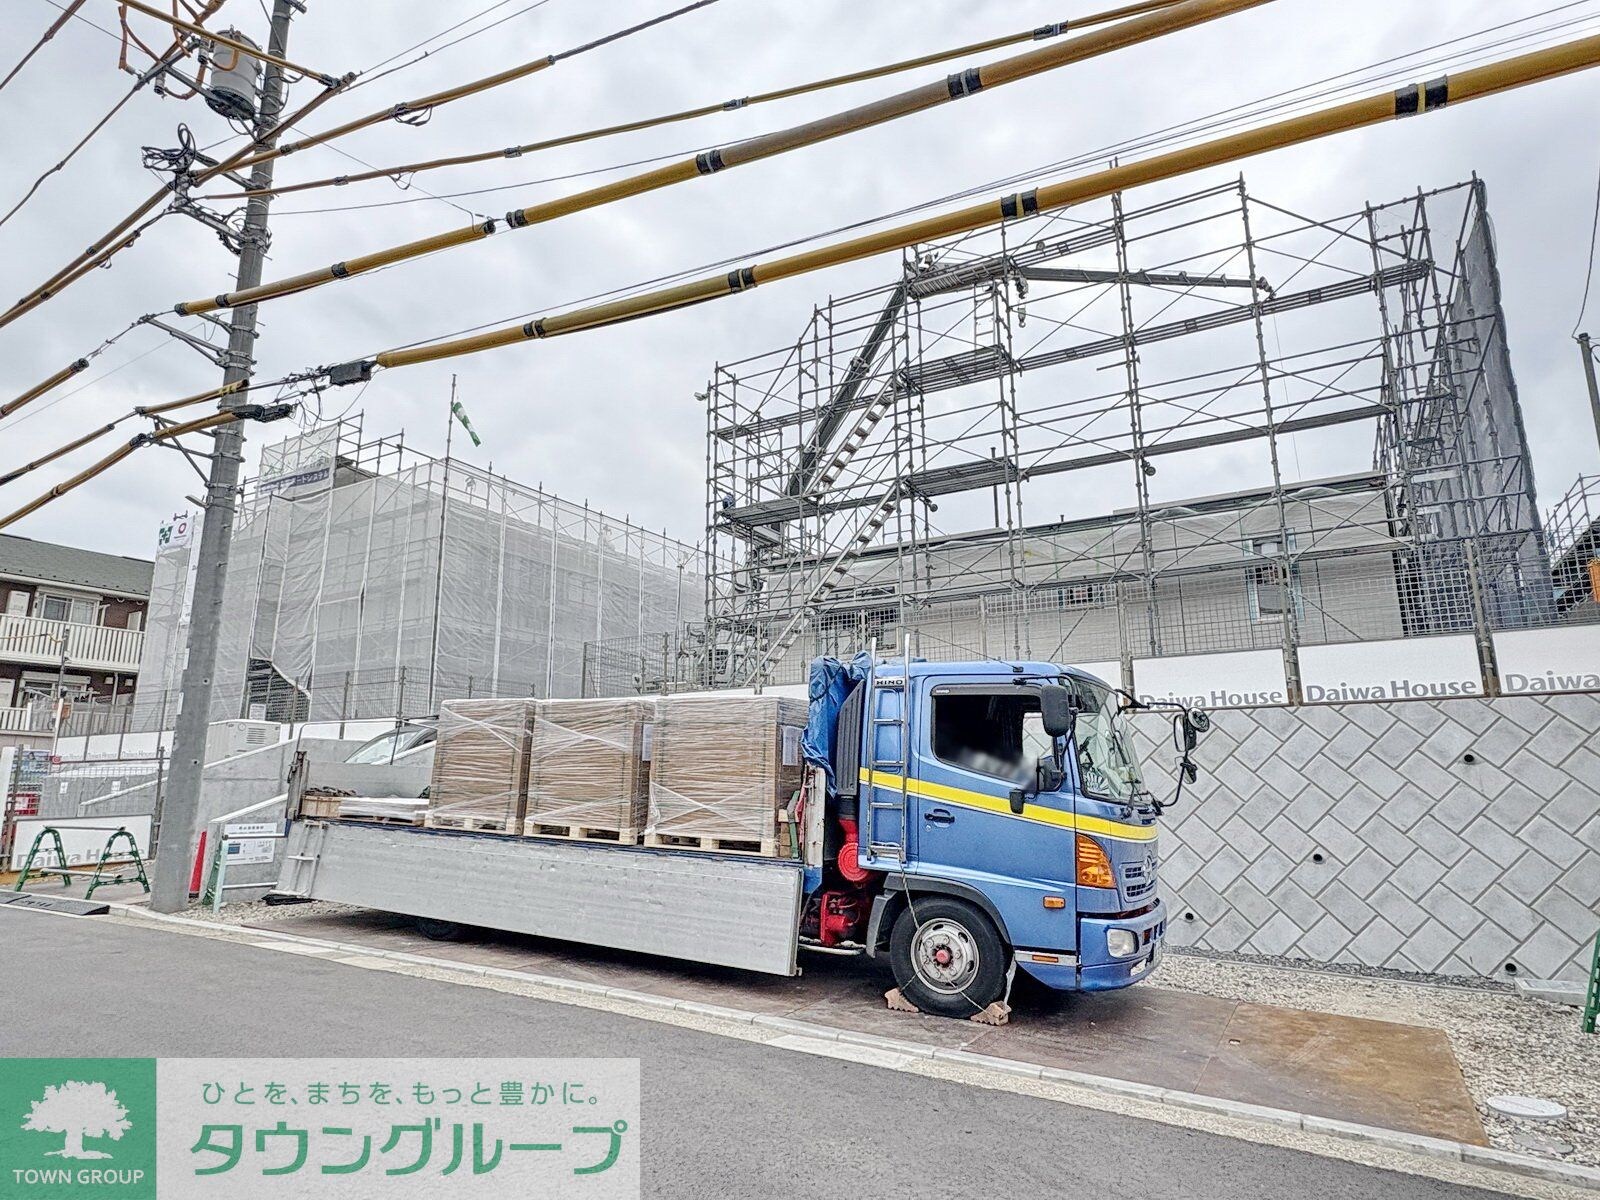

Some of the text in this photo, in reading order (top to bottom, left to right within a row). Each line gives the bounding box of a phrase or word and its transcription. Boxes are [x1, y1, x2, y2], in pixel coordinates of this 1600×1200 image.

[1306, 679, 1477, 702] Daiwa House
[1505, 671, 1600, 692] Daiwa
[1139, 690, 1283, 709] Daiwa House
[17, 851, 81, 868] Daia
